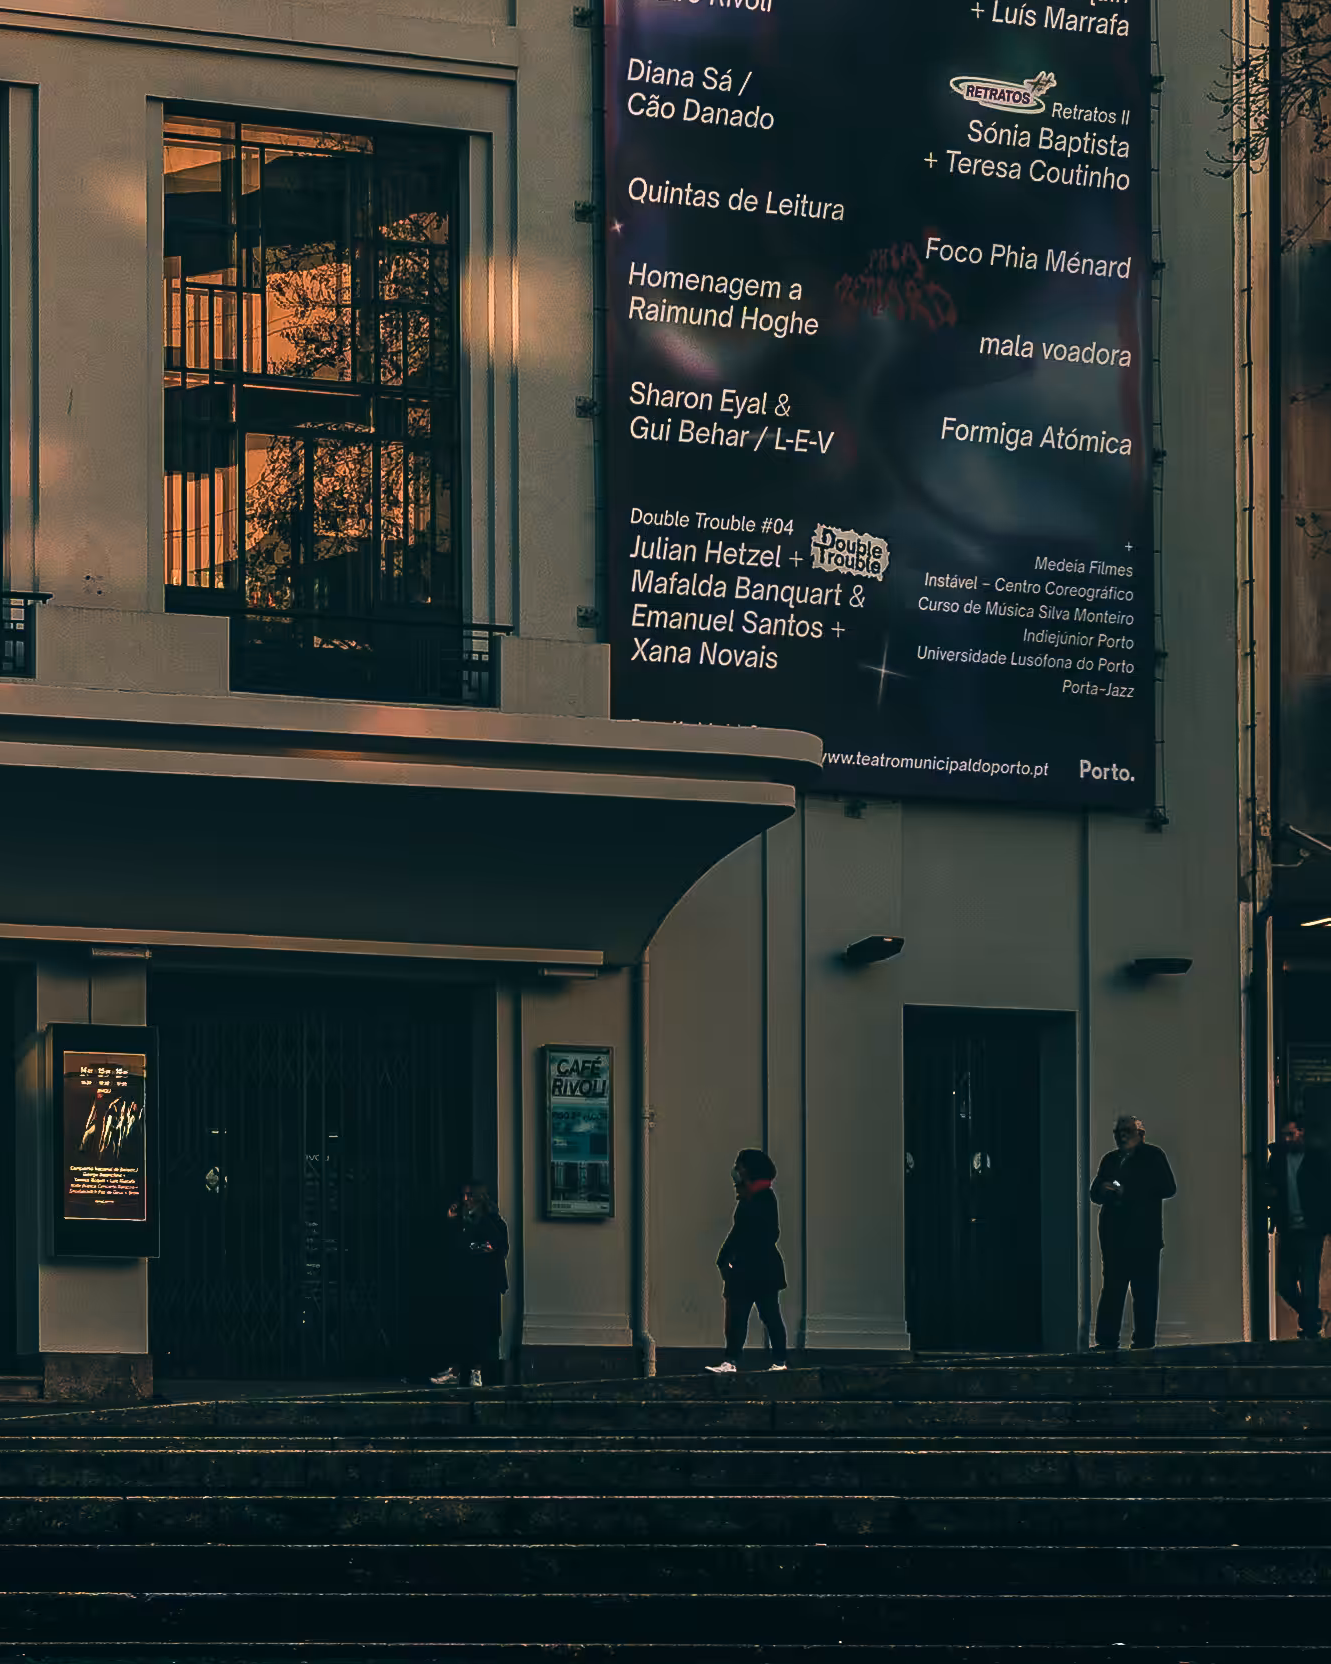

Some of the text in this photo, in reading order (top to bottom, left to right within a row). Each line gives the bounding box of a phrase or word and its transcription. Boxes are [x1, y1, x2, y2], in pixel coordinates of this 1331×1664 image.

[970, 0, 1130, 37] + Luís Marrafa
[626, 57, 753, 97] Diana Sá /
[627, 91, 775, 130] Cão Danado
[965, 84, 1032, 105] RETRATOS
[1051, 101, 1131, 126] Retratos II
[967, 119, 1130, 159] Sónia Baptista
[923, 149, 1130, 191] + Teresa Coutinho
[628, 176, 845, 221] Quintas de Leitura
[925, 236, 983, 265] Foco
[990, 243, 1038, 271] Phia
[1045, 248, 1132, 279] Ménard
[628, 261, 782, 301] Homenagem
[788, 282, 803, 301] a
[628, 295, 819, 339] Raimund Hoghe
[979, 334, 1132, 368] mala voadora
[629, 381, 792, 420] Sharon Eyal &
[630, 415, 836, 455] Gui Behar / L-E-V
[940, 416, 1132, 456] Formiga Atómica
[630, 507, 794, 536] Double Trouble #04
[629, 534, 804, 568] Julian Hetzel +
[812, 541, 881, 575] Trouble
[821, 527, 883, 560] Double
[1034, 555, 1134, 578] Medeia Filmes
[630, 568, 866, 609] Mafalda Banquart &
[924, 571, 978, 590] Instável
[994, 577, 1041, 595] Centro
[1044, 581, 1134, 602] Coreográfico
[631, 603, 846, 639] Emanuel Santos +
[918, 595, 1134, 626] Curso de Música Silva Monteiro
[630, 637, 779, 670] Xana Novais
[1023, 627, 1135, 650] Indiejúnior Porto
[916, 645, 1135, 674] Universidade Lusófona do Porto
[1062, 679, 1135, 698] Porta-Jazz
[1079, 759, 1136, 782] Porto.
[556, 1056, 602, 1078] CAFÉ
[550, 1077, 608, 1098] RIVOLI
